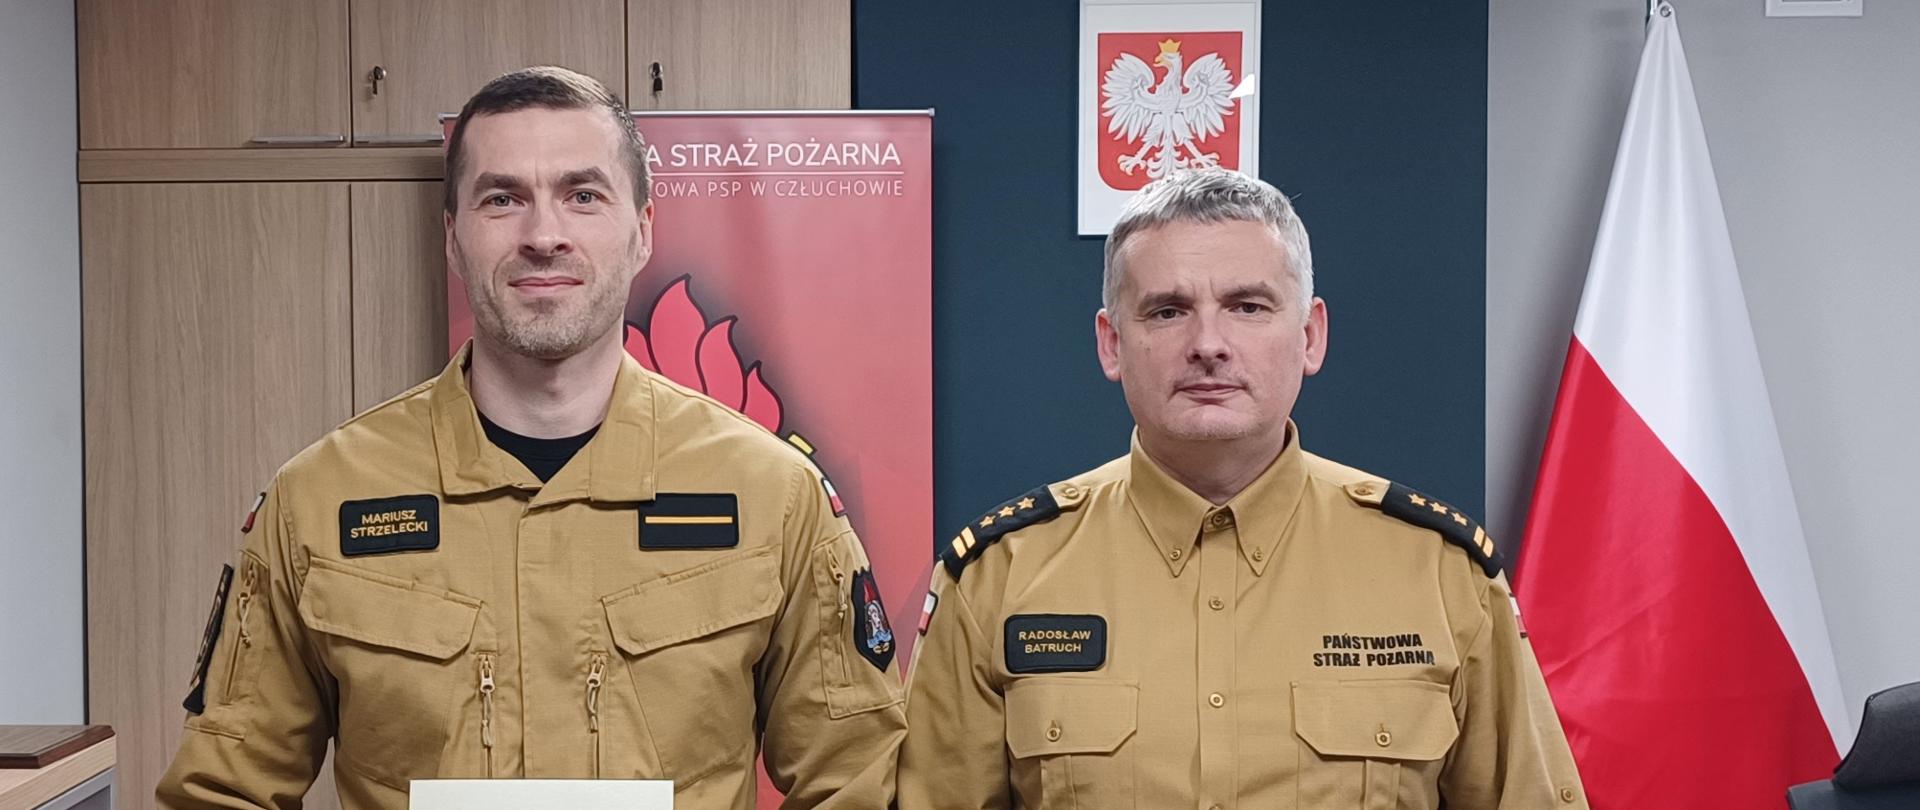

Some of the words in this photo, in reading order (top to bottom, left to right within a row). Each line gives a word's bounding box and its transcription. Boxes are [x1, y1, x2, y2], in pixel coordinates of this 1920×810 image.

[645, 144, 663, 167] A
[670, 137, 759, 167] STRAŻ
[767, 137, 901, 167] POŻARNA
[650, 180, 700, 198] OWA
[707, 181, 742, 197] PSP
[750, 181, 766, 196] W
[774, 180, 903, 197] CZŁUCHOWIE
[361, 509, 417, 525] MARIUSZ
[350, 520, 429, 539] STRZELECKI
[1018, 630, 1091, 641] RADOSŁAW
[1322, 633, 1423, 650] PAŃSTWOWA
[1024, 643, 1082, 654] BATRUCH
